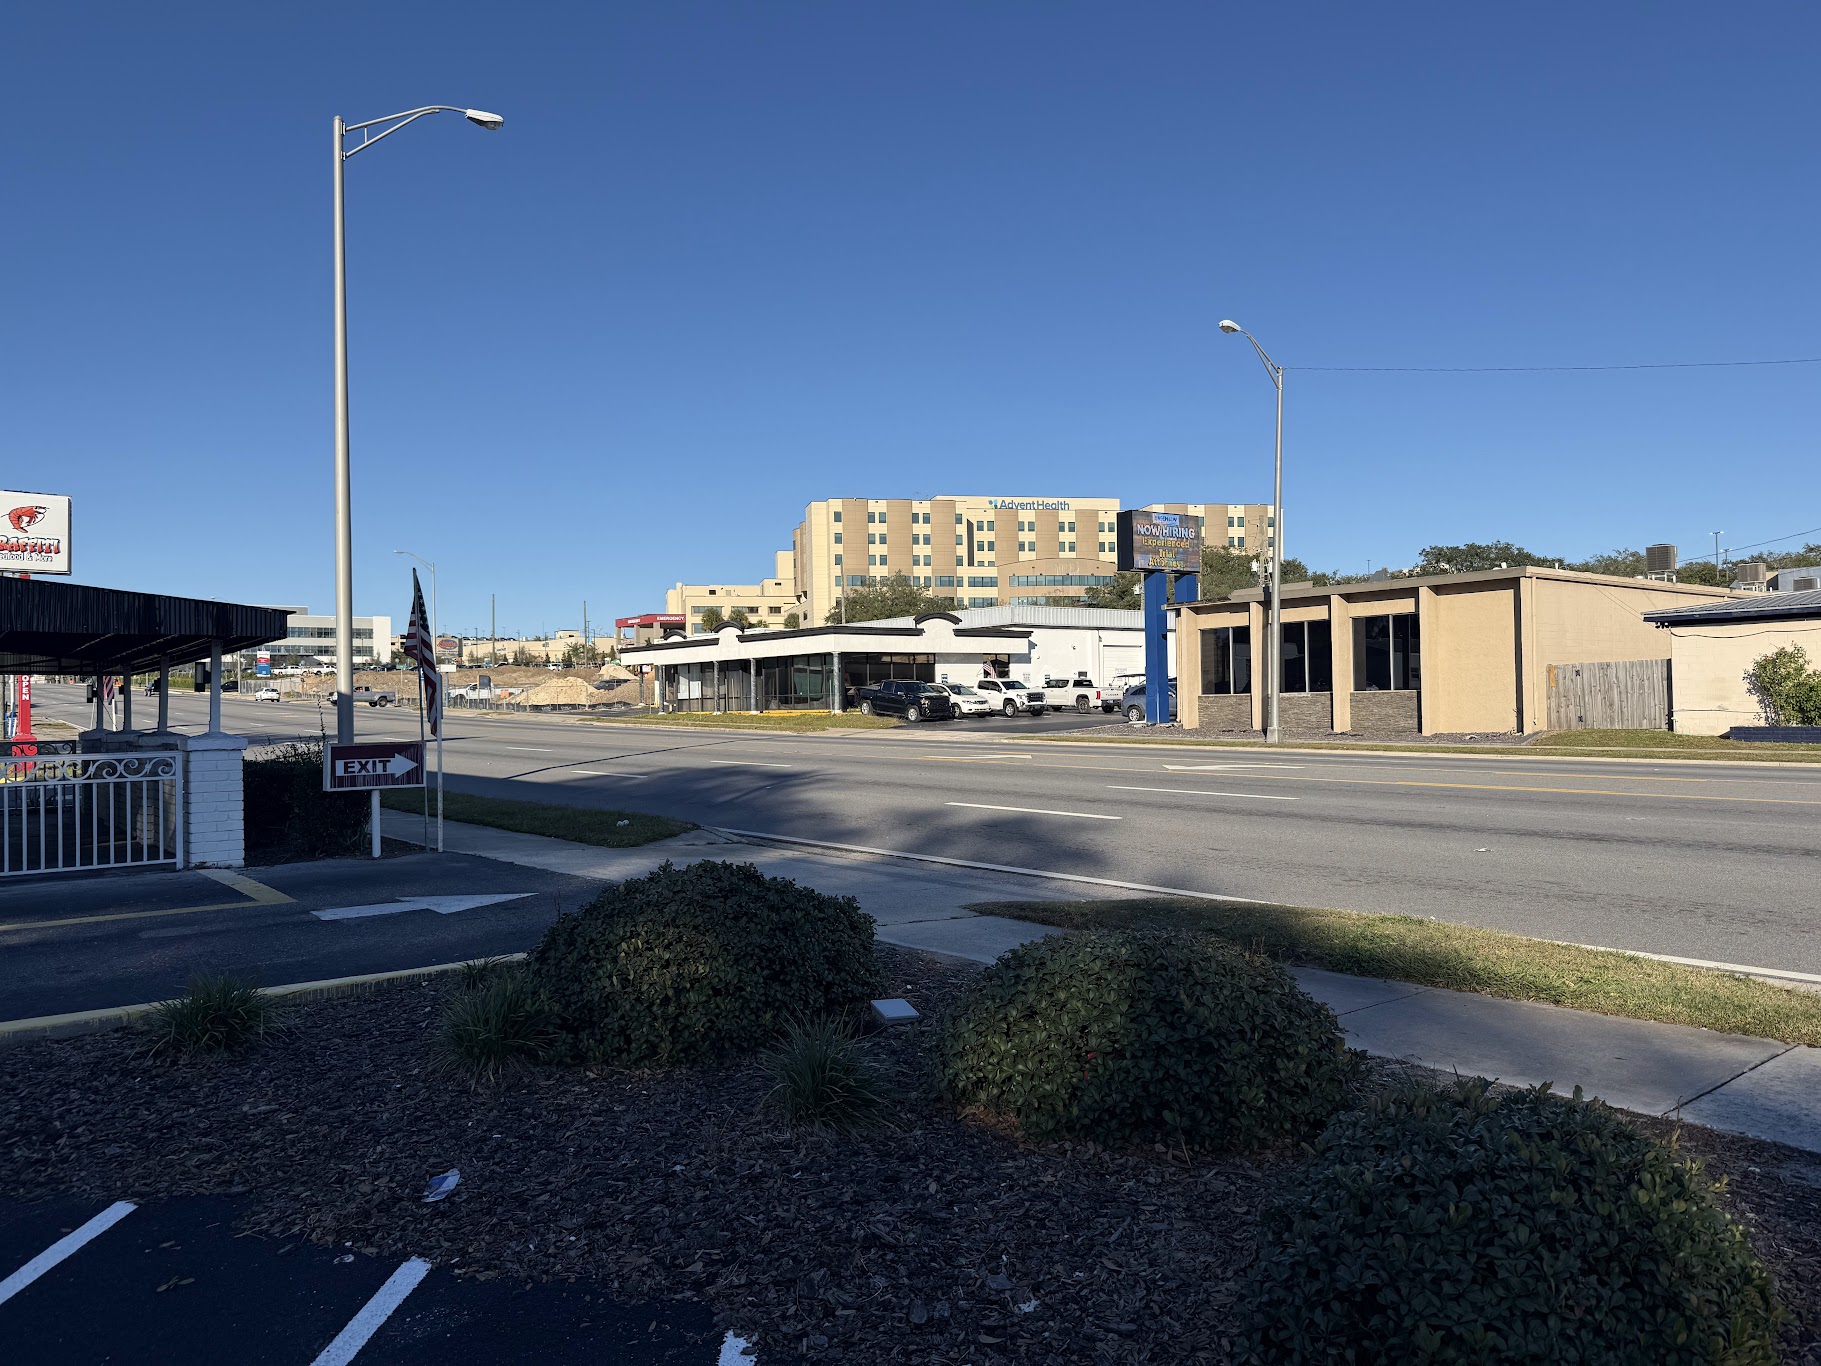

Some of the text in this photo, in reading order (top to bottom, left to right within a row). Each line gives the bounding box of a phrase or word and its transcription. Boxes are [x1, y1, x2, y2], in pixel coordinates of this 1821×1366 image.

[1000, 499, 1070, 510] AdventHealth
[1137, 523, 1196, 539] NOW HIRING
[1142, 537, 1190, 548] Experienced
[343, 760, 391, 774] EXIT
